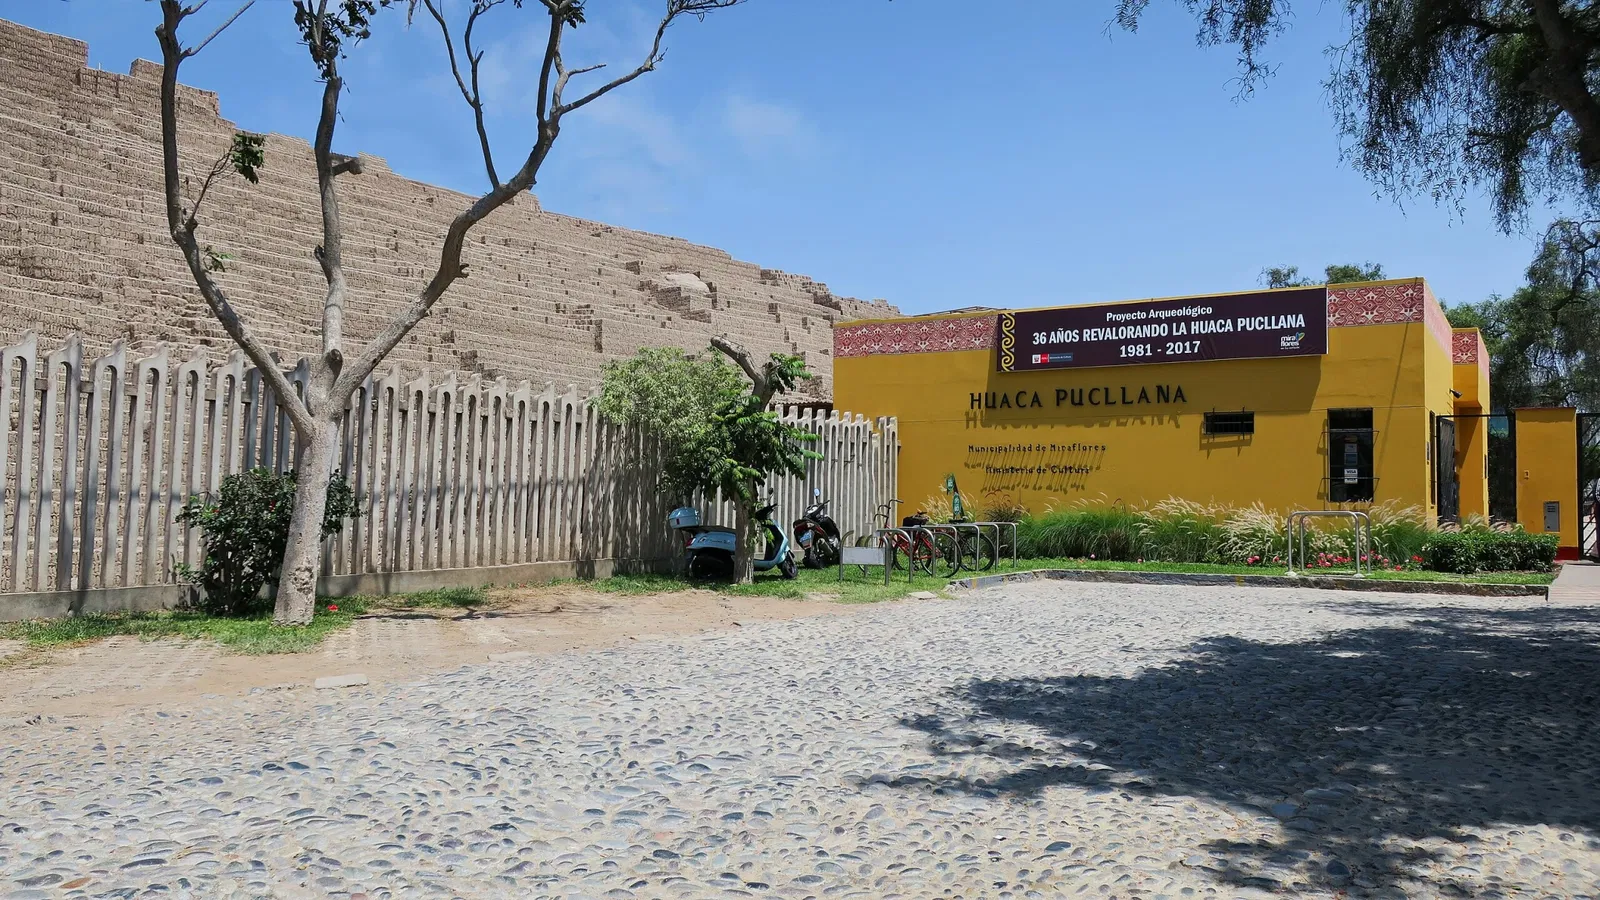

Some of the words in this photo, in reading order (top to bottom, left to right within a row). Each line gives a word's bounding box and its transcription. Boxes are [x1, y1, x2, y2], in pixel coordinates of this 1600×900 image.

[1106, 310, 1147, 322] Proyecto
[1149, 305, 1213, 319] Arqueológico
[1032, 332, 1047, 345] 36
[1049, 327, 1080, 344] AÑOS
[1083, 323, 1169, 342] REVALORANDO
[1172, 322, 1187, 336] LA
[1191, 319, 1234, 335] HUACA
[1237, 314, 1305, 332] PUCLLANA
[1120, 343, 1153, 358] 1981
[1165, 340, 1201, 355] 2017
[969, 391, 1043, 410] HUACA
[1055, 385, 1187, 407] PUCLLANA
[968, 444, 1032, 454] Municipalidad
[1035, 444, 1047, 452] de
[1050, 443, 1106, 452] Miraflores
[985, 466, 1034, 474] Ministerio
[1036, 465, 1047, 474] de
[1050, 465, 1090, 474] Cultura
